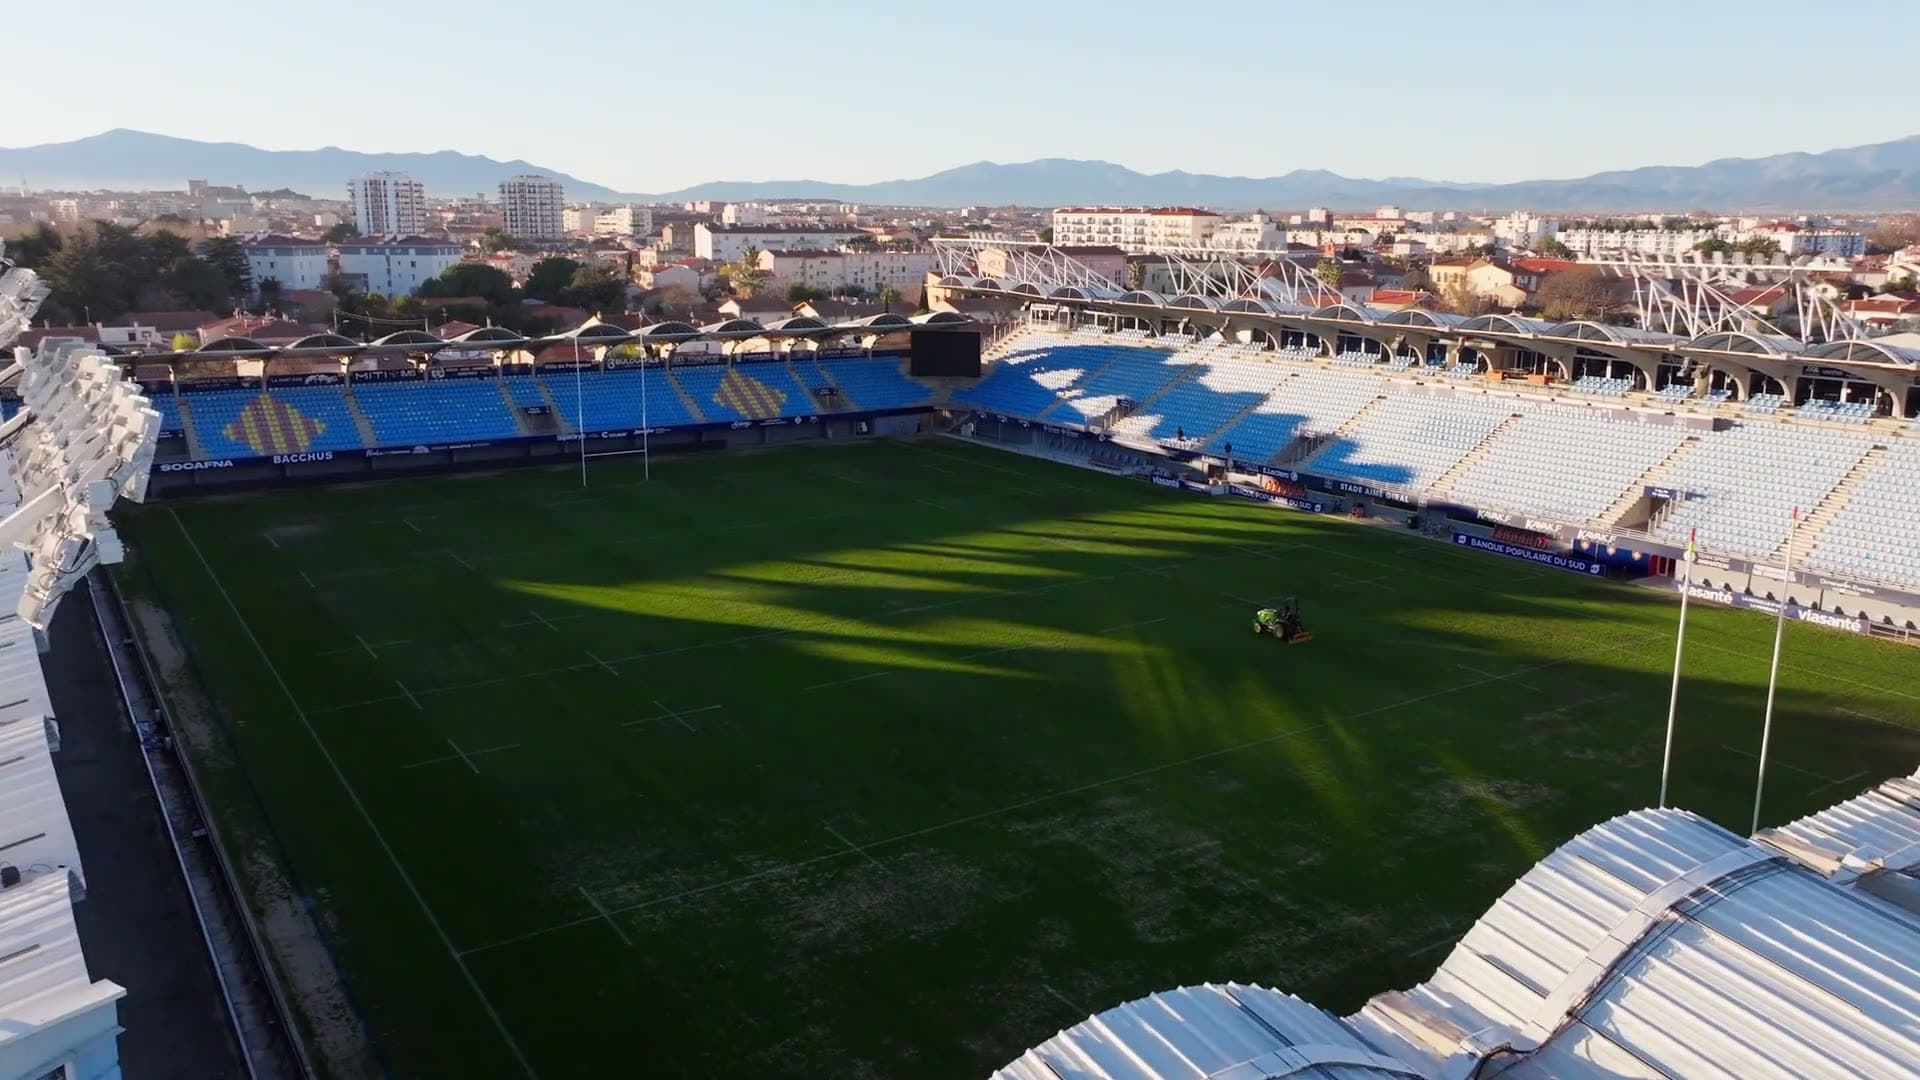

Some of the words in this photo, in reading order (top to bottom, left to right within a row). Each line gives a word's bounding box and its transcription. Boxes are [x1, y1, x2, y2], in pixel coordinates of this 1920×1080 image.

[1541, 401, 1593, 415] partenaire
[160, 460, 233, 472] SOCAFNA
[273, 451, 333, 464] BACCHUS
[1340, 483, 1363, 494] STADE
[1385, 492, 1409, 503] GIRAL
[1289, 498, 1299, 506] DU
[1299, 501, 1312, 509] SUD
[1471, 537, 1504, 553] BANQUE
[1506, 544, 1553, 564] POPULAIRE
[1554, 556, 1567, 566] DU
[1568, 560, 1585, 570] SUD
[1678, 584, 1733, 604] vasanté
[1798, 609, 1861, 632] viasanté
